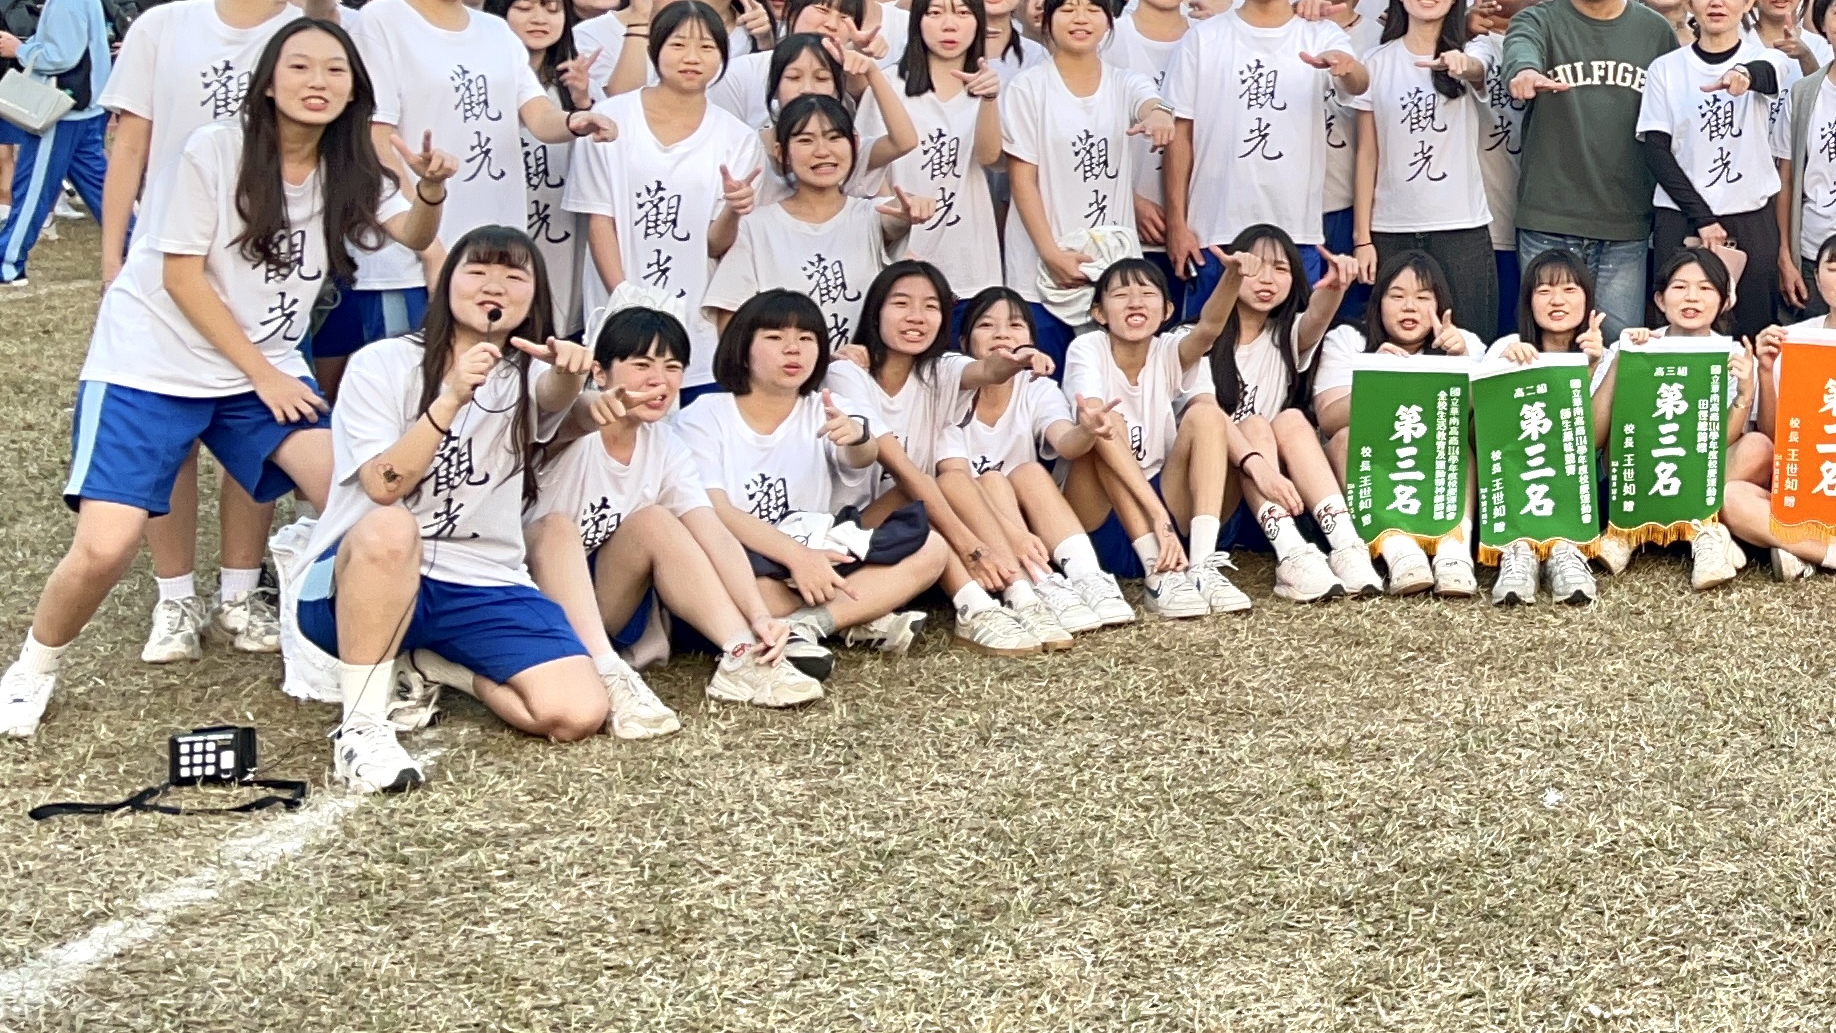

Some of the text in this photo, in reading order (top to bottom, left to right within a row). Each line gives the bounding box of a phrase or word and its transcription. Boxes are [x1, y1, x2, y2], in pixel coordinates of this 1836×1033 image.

[450, 64, 506, 182] 觀光
[1237, 59, 1287, 160] 觀光
[1400, 84, 1448, 184] 觀光
[1698, 92, 1743, 189] 觀光
[920, 127, 961, 231] 觀光
[1070, 128, 1118, 229] 觀光
[1514, 383, 1548, 398] 高二組
[1654, 367, 1688, 377] 高三組
[422, 430, 489, 538] 觀光
[1386, 405, 1427, 514] 第三名
[1518, 401, 1556, 516] 第三名
[1649, 383, 1689, 496] 第三名
